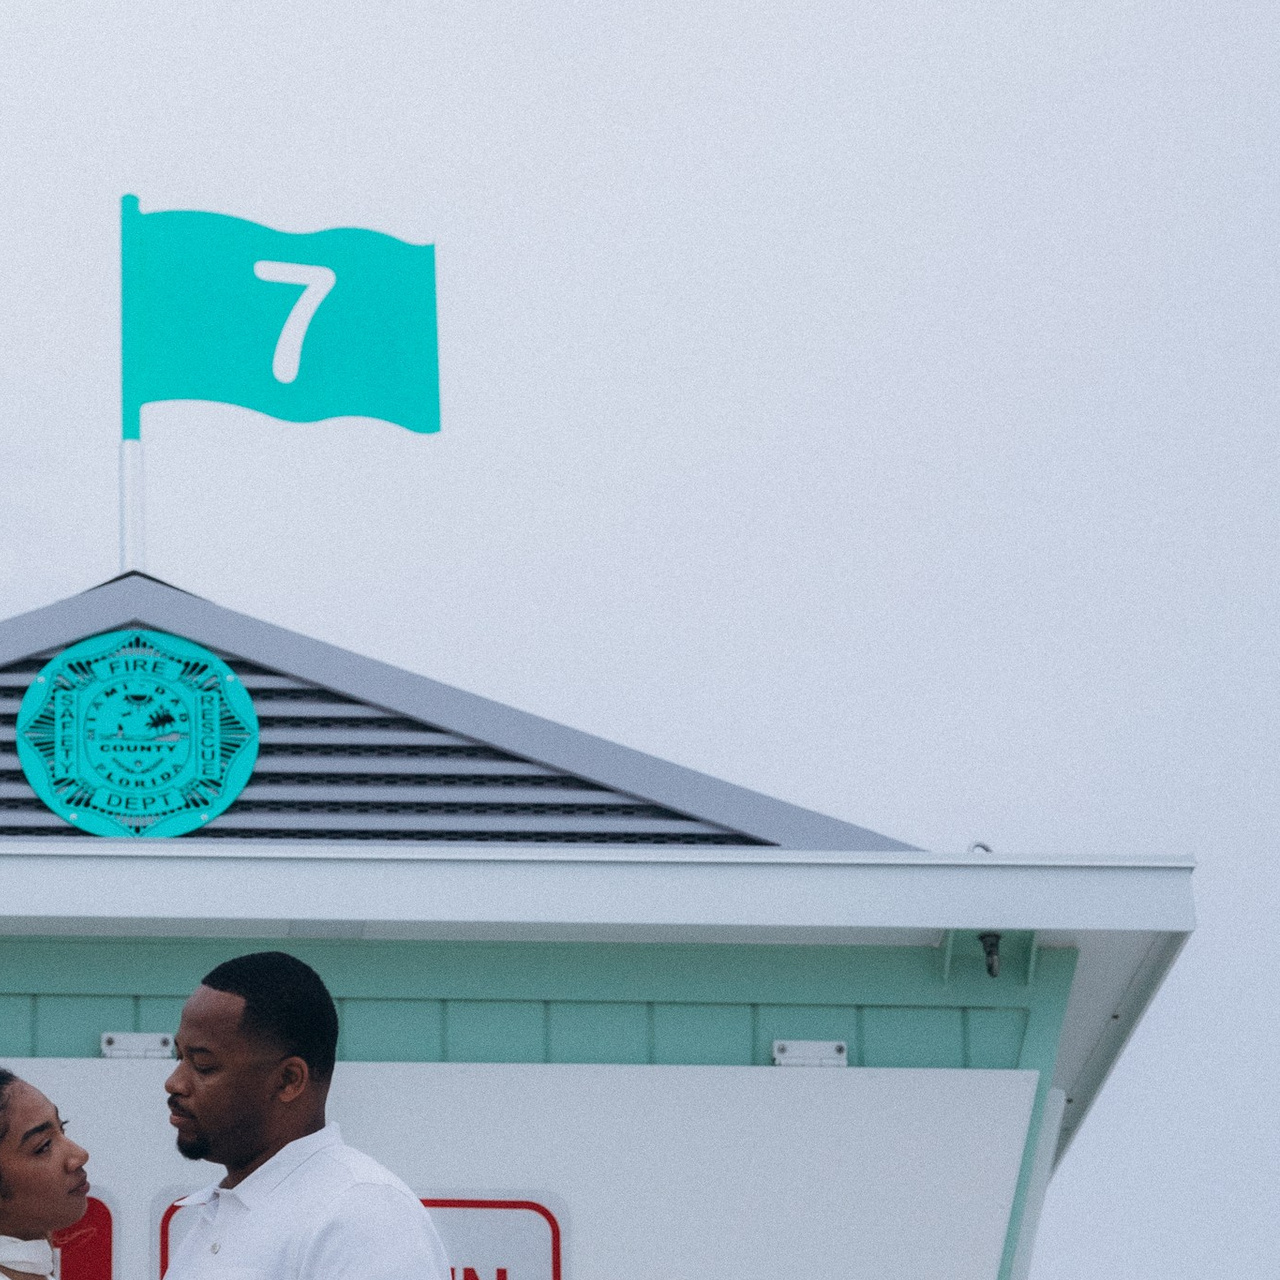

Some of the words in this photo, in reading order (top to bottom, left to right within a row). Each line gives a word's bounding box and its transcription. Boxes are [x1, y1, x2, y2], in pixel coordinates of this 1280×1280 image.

[253, 260, 337, 384] 7
[109, 659, 167, 674] FIRE
[60, 693, 74, 774] SAFETY
[201, 694, 215, 776] RESCUE
[100, 744, 176, 752] COUNTY
[95, 763, 184, 787] FLORIDA
[107, 793, 171, 811] DEPT
